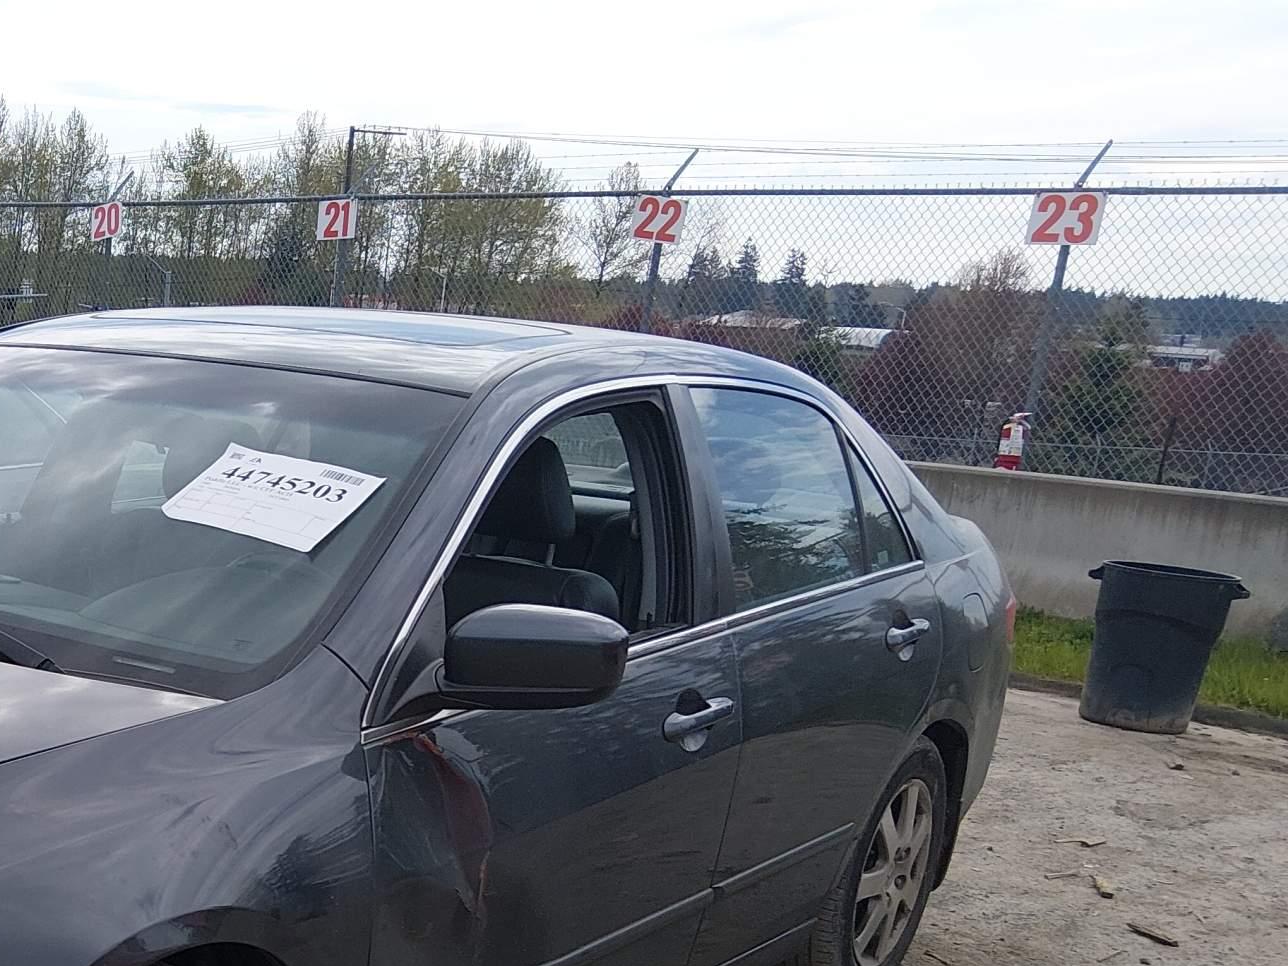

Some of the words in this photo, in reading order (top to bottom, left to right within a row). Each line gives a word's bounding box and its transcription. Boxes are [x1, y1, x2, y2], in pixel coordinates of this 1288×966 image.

[93, 202, 121, 239] 20
[323, 202, 352, 239] 21
[634, 197, 682, 241] 22
[1031, 193, 1100, 244] 23
[222, 466, 348, 503] 44745203
